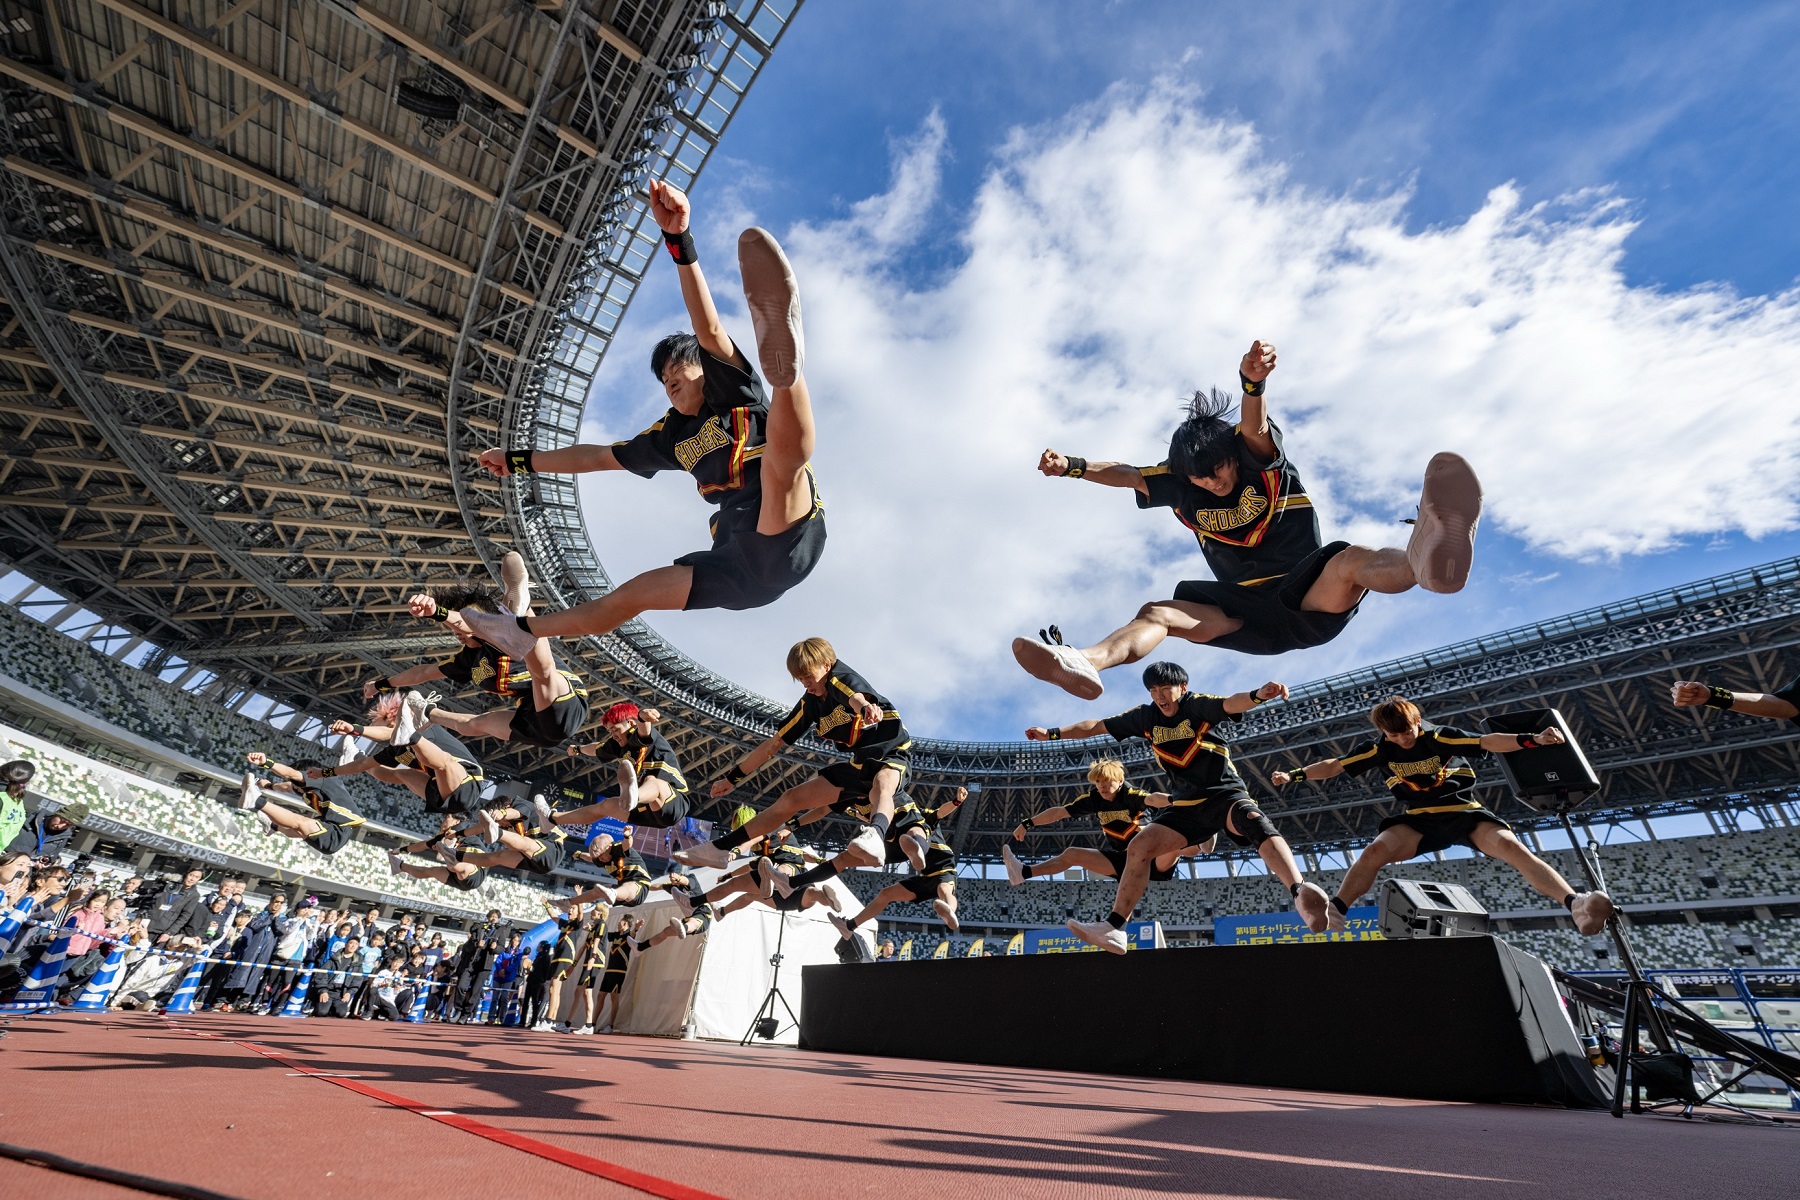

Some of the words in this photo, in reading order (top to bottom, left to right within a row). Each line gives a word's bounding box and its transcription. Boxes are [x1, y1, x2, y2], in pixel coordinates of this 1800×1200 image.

[512, 456, 529, 474] 21
[1196, 485, 1268, 532] SHOCKERS
[1153, 718, 1195, 746] SHOCKERS
[1388, 755, 1442, 778] SHOCKERS
[179, 843, 229, 865] SHOCKERS
